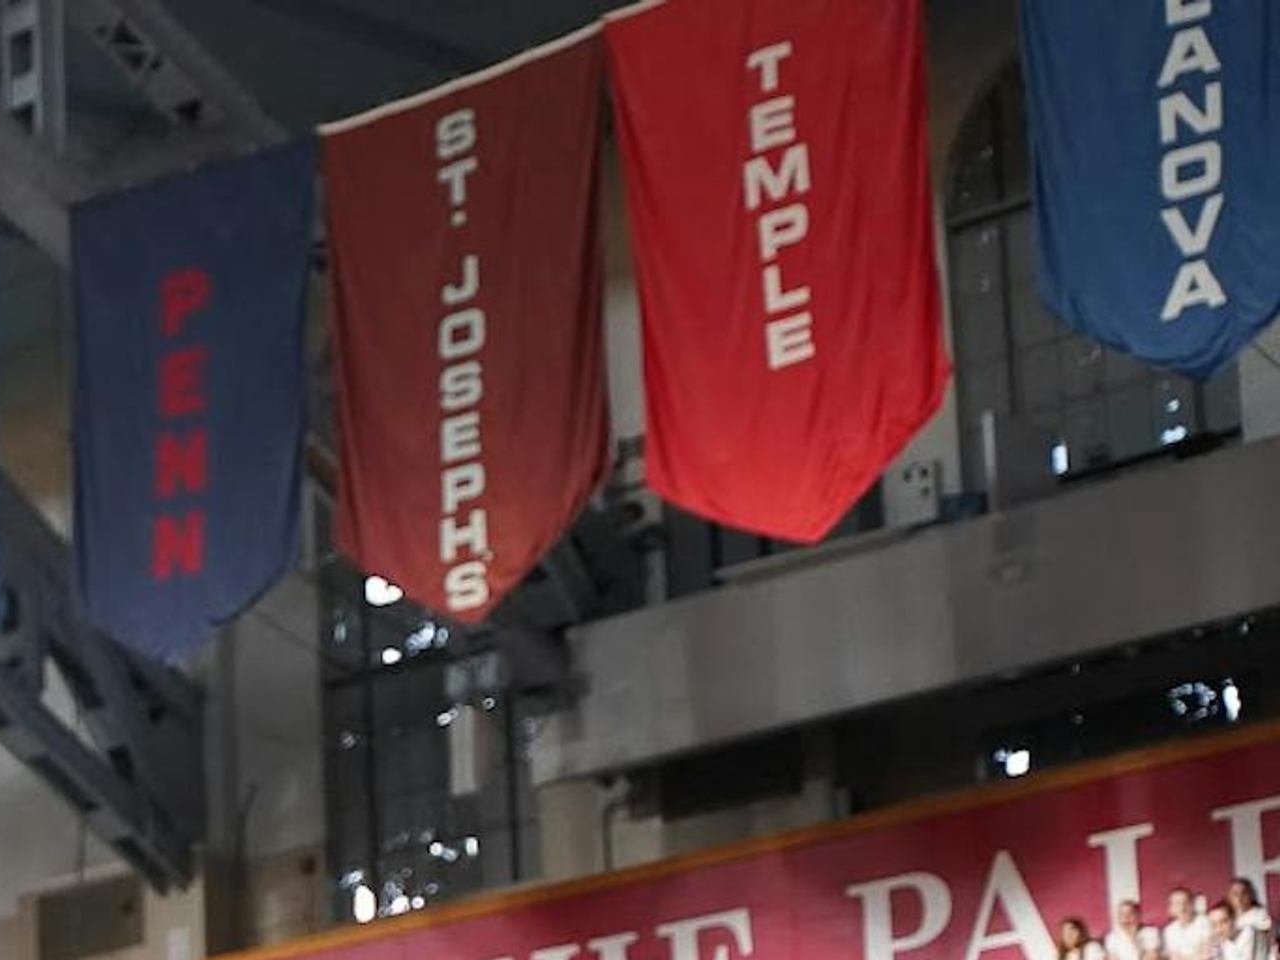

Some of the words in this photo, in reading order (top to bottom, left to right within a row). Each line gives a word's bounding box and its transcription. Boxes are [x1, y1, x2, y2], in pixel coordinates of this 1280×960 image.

[435, 108, 479, 227] ST.
[743, 40, 817, 371] TEMPLE
[151, 266, 213, 583] PENN
